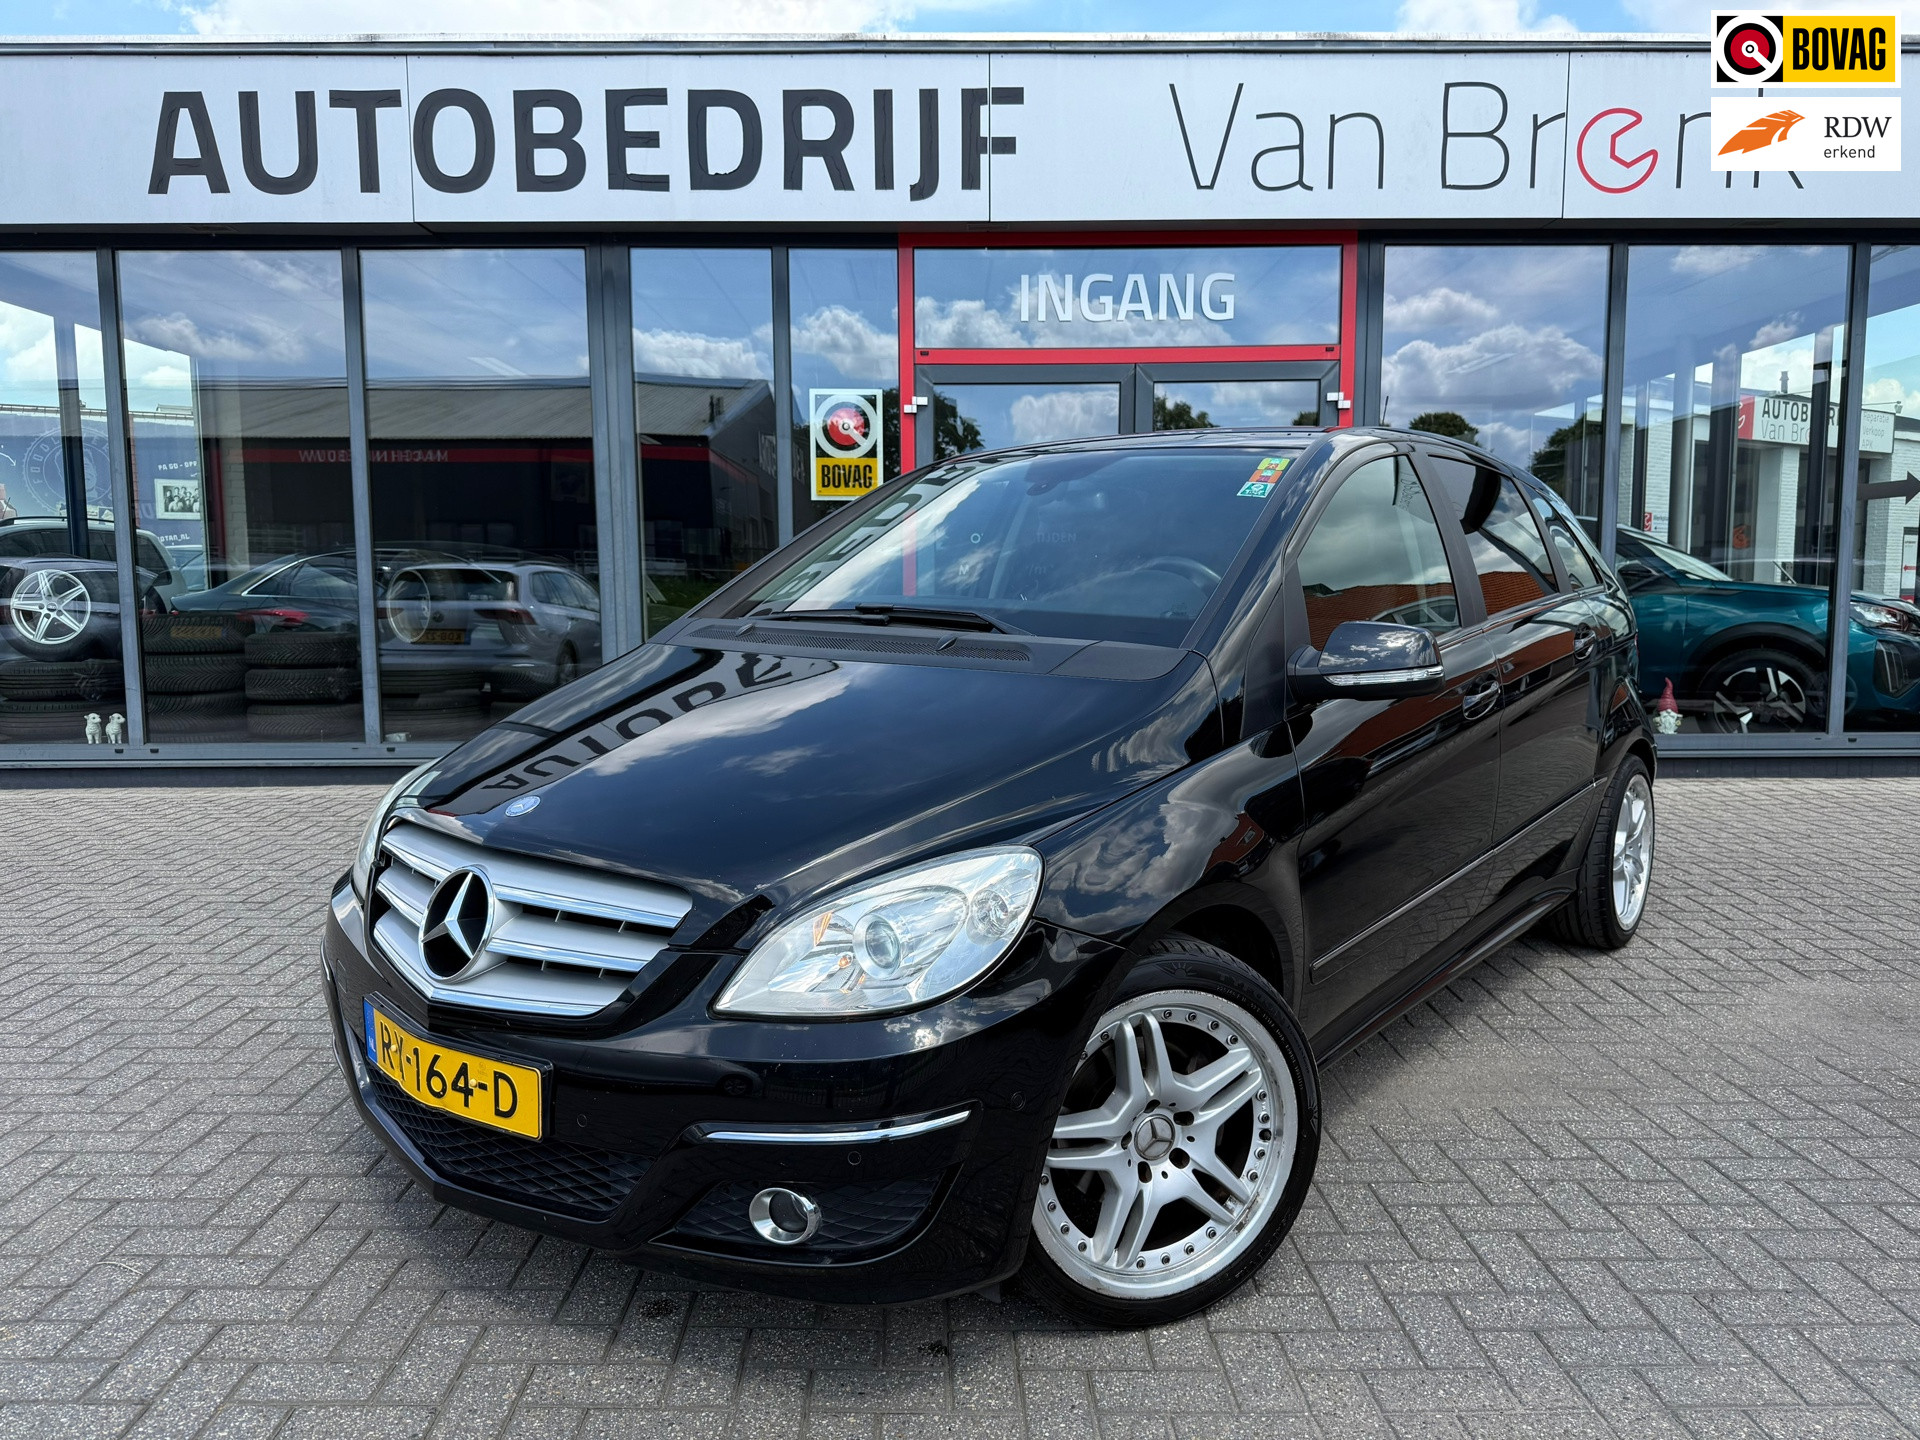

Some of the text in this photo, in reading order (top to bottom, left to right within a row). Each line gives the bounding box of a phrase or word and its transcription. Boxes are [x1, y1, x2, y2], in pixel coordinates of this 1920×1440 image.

[147, 86, 1025, 202] AUTOBEDRIJF
[1169, 82, 1385, 192] Van
[1020, 272, 1236, 322] INGANG
[1761, 420, 1786, 441] Van
[821, 464, 873, 489] BOVAG
